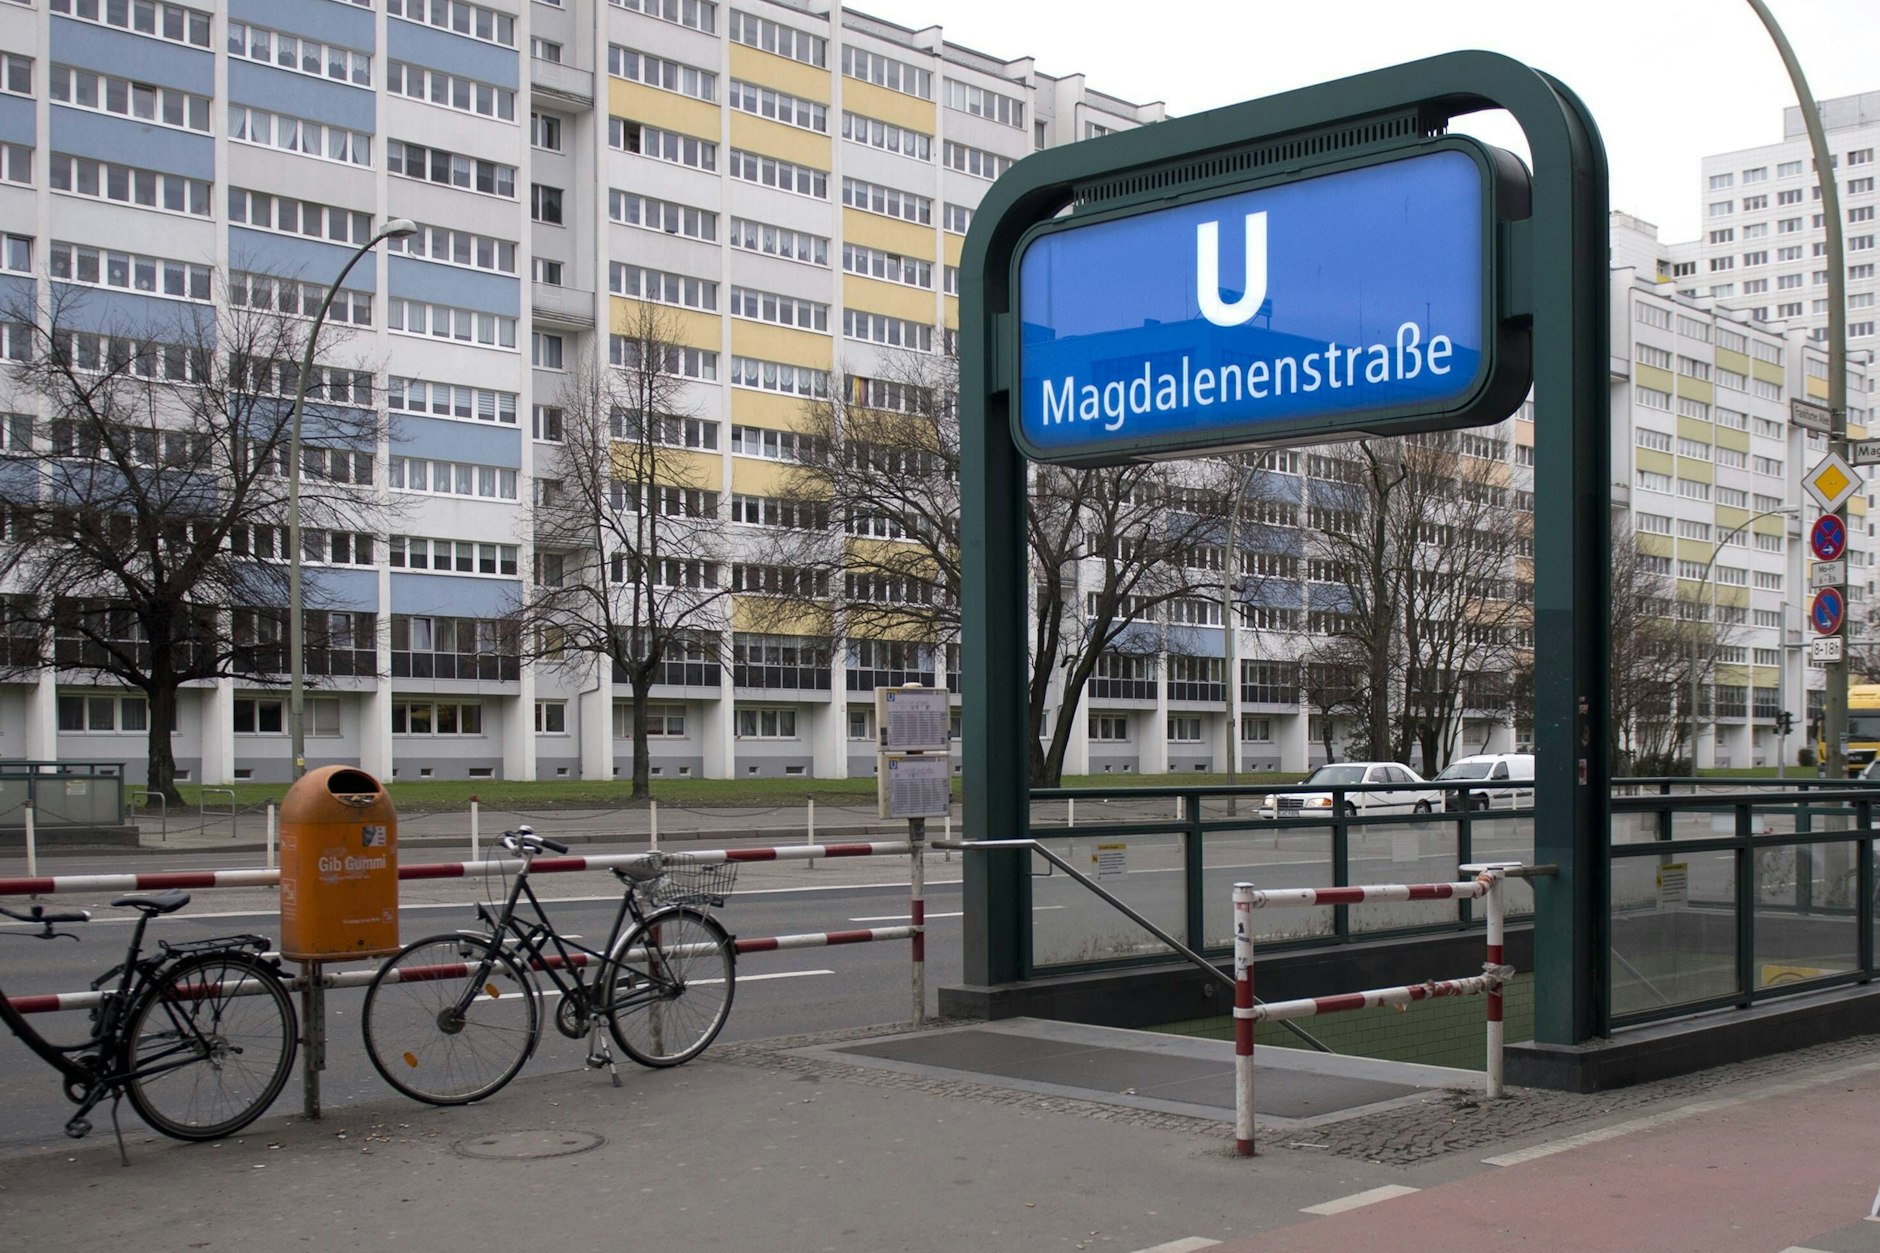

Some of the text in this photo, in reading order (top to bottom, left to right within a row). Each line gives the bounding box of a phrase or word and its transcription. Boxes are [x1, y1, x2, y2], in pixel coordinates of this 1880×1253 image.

[1197, 210, 1268, 327] U
[1041, 321, 1453, 432] Magdalenenstraße
[319, 853, 386, 872] Gib Gummi
